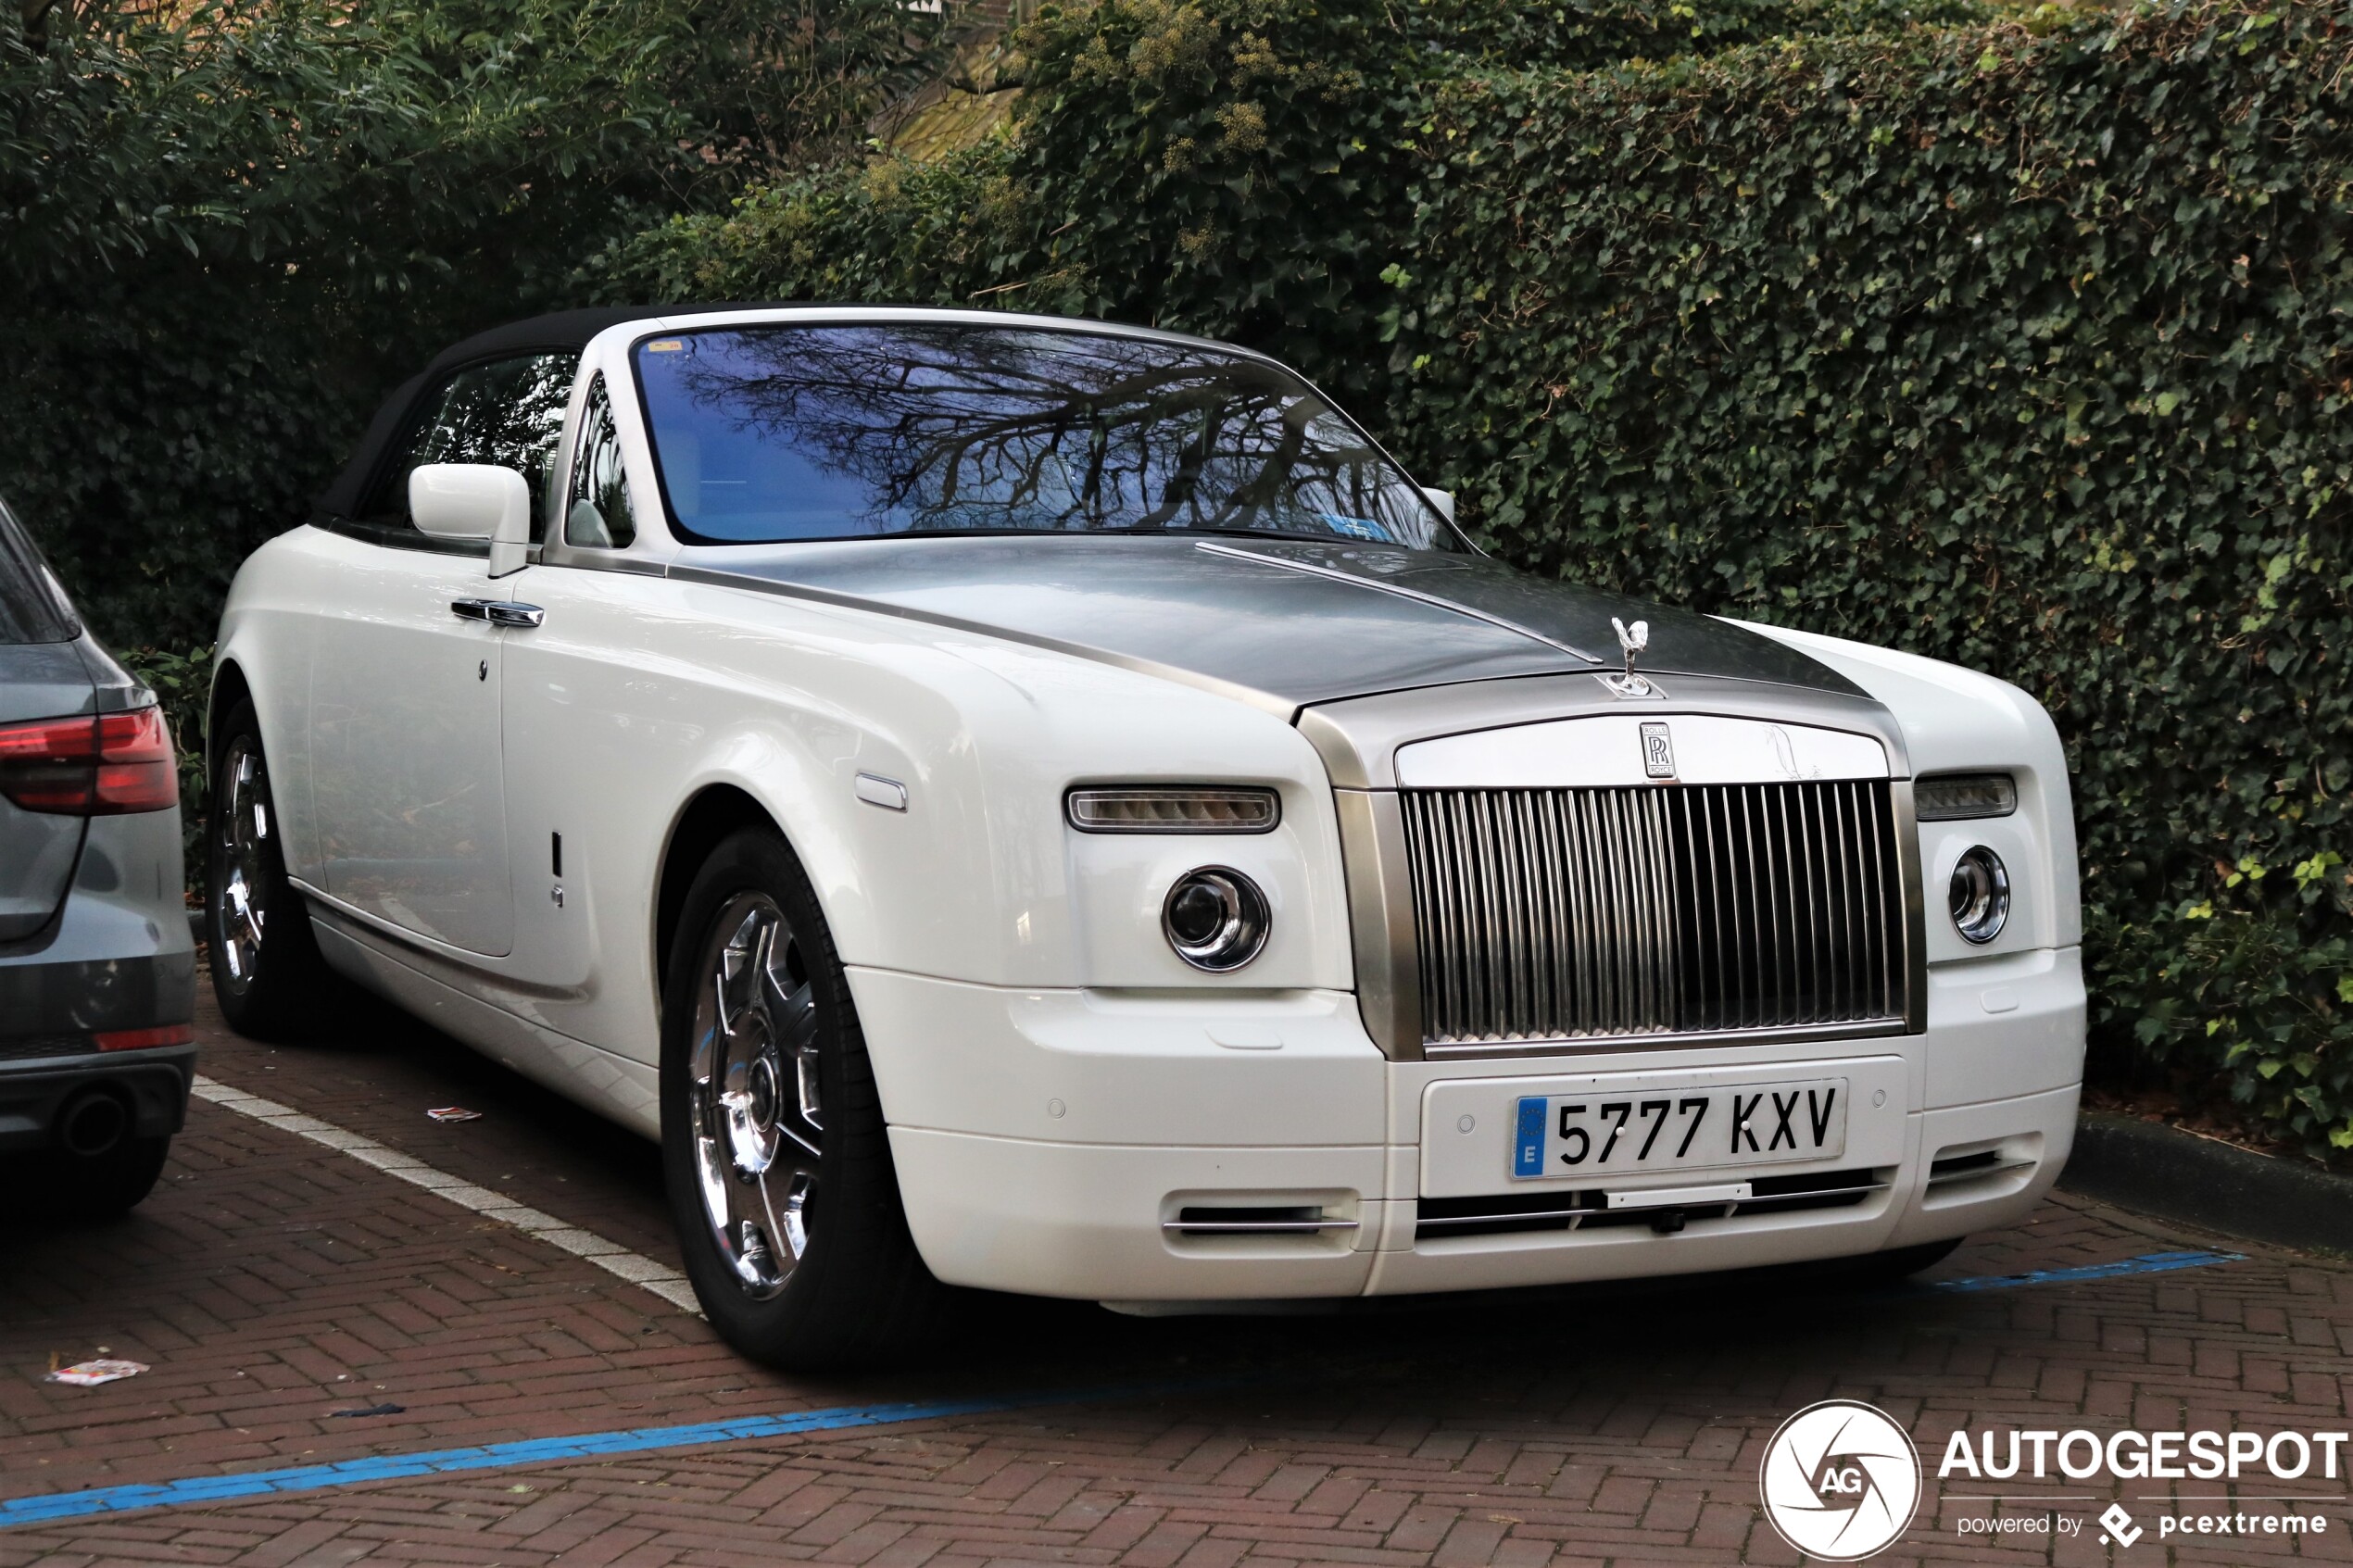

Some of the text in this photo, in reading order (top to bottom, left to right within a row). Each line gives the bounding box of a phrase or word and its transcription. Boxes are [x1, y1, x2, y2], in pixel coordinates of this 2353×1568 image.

[1558, 1088, 1836, 1165] 5777 KXV
[1524, 1146, 1536, 1163] E
